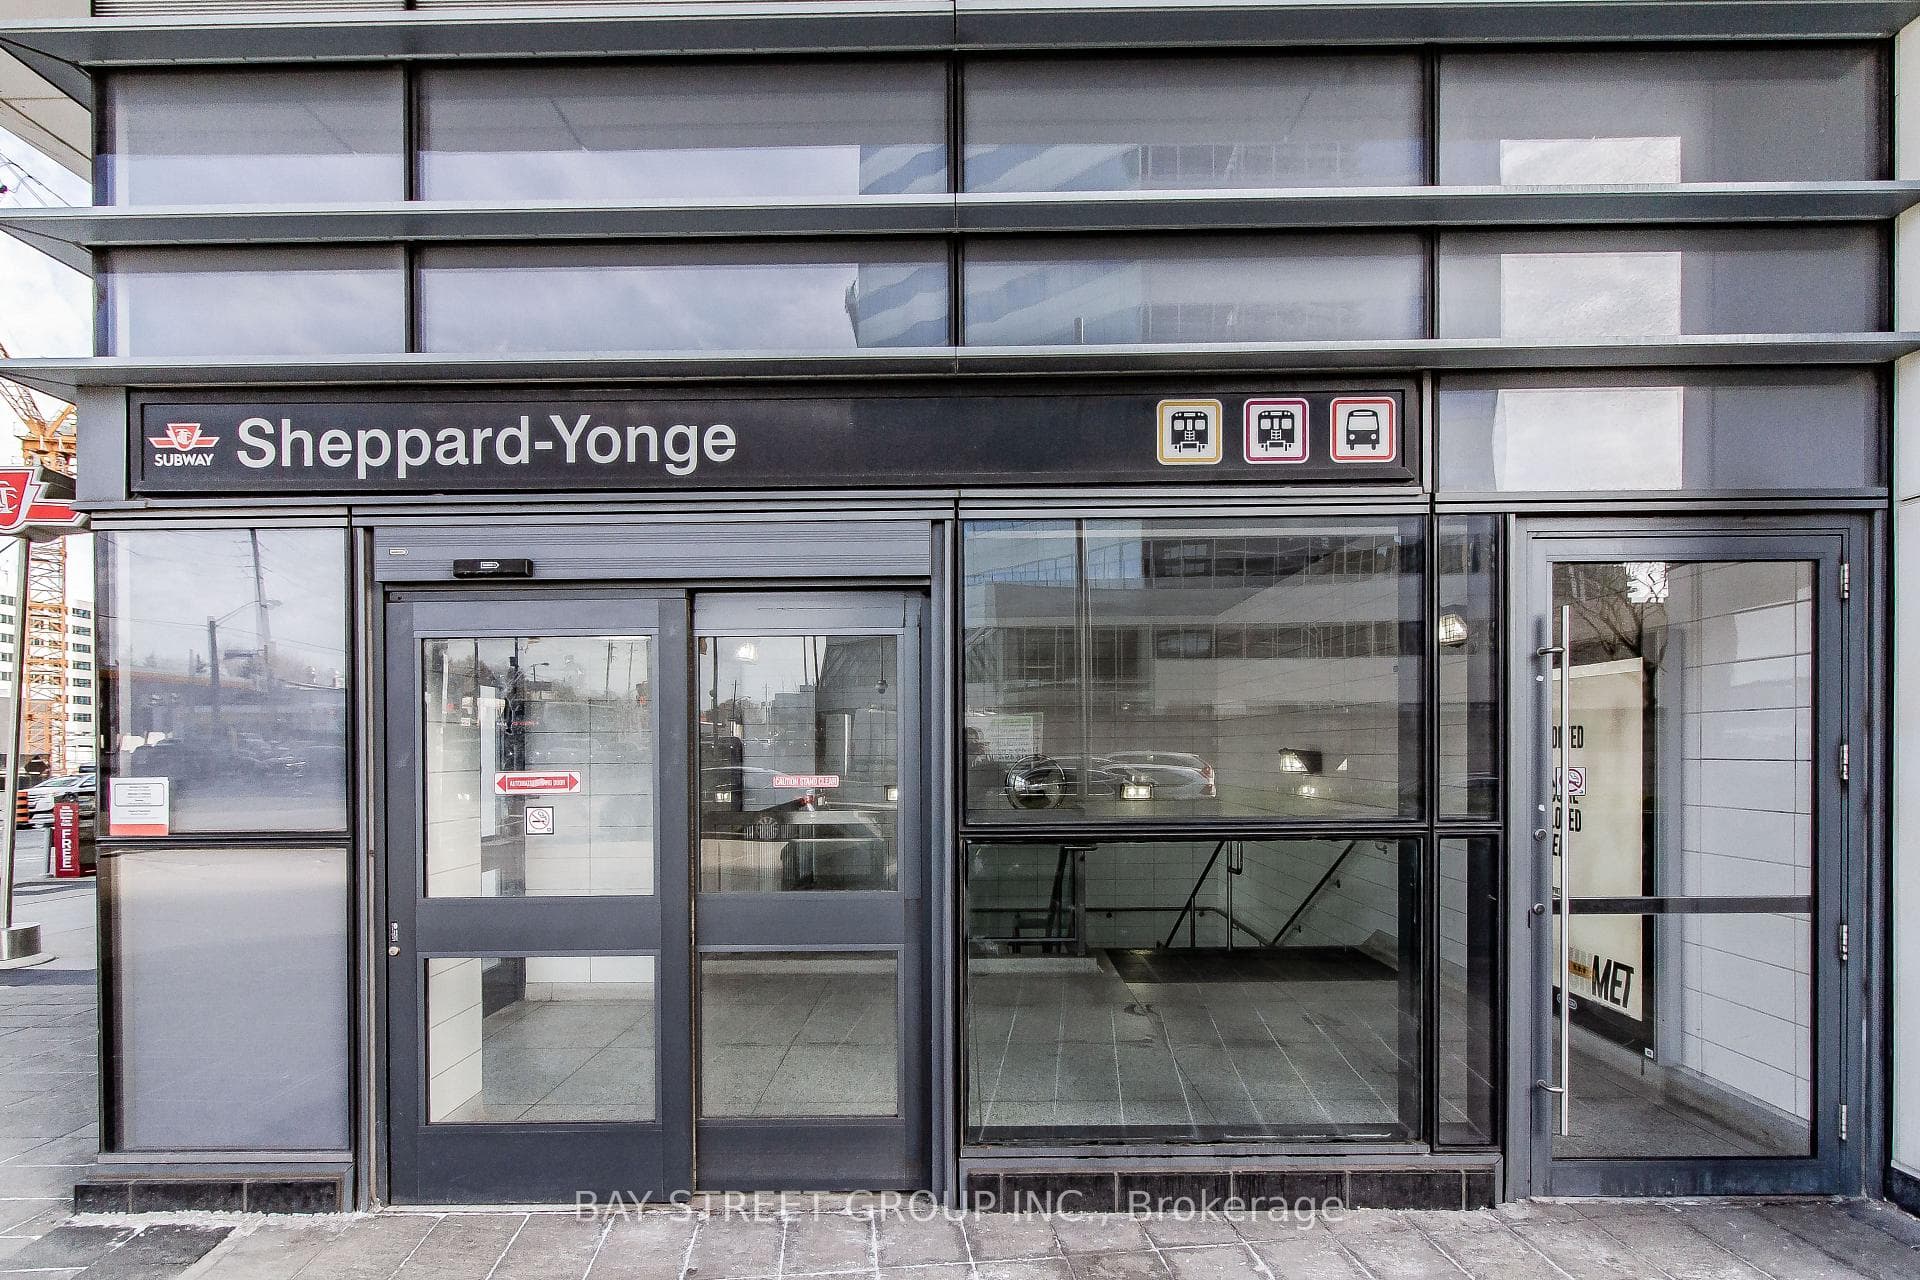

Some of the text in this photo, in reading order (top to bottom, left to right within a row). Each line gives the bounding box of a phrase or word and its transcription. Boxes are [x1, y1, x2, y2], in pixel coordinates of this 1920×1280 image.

[154, 453, 214, 467] SUBWAY
[237, 414, 737, 480] Sheppard-Yonge
[775, 776, 799, 786] CAUTION
[800, 776, 817, 786] STAND
[61, 828, 73, 869] FREE
